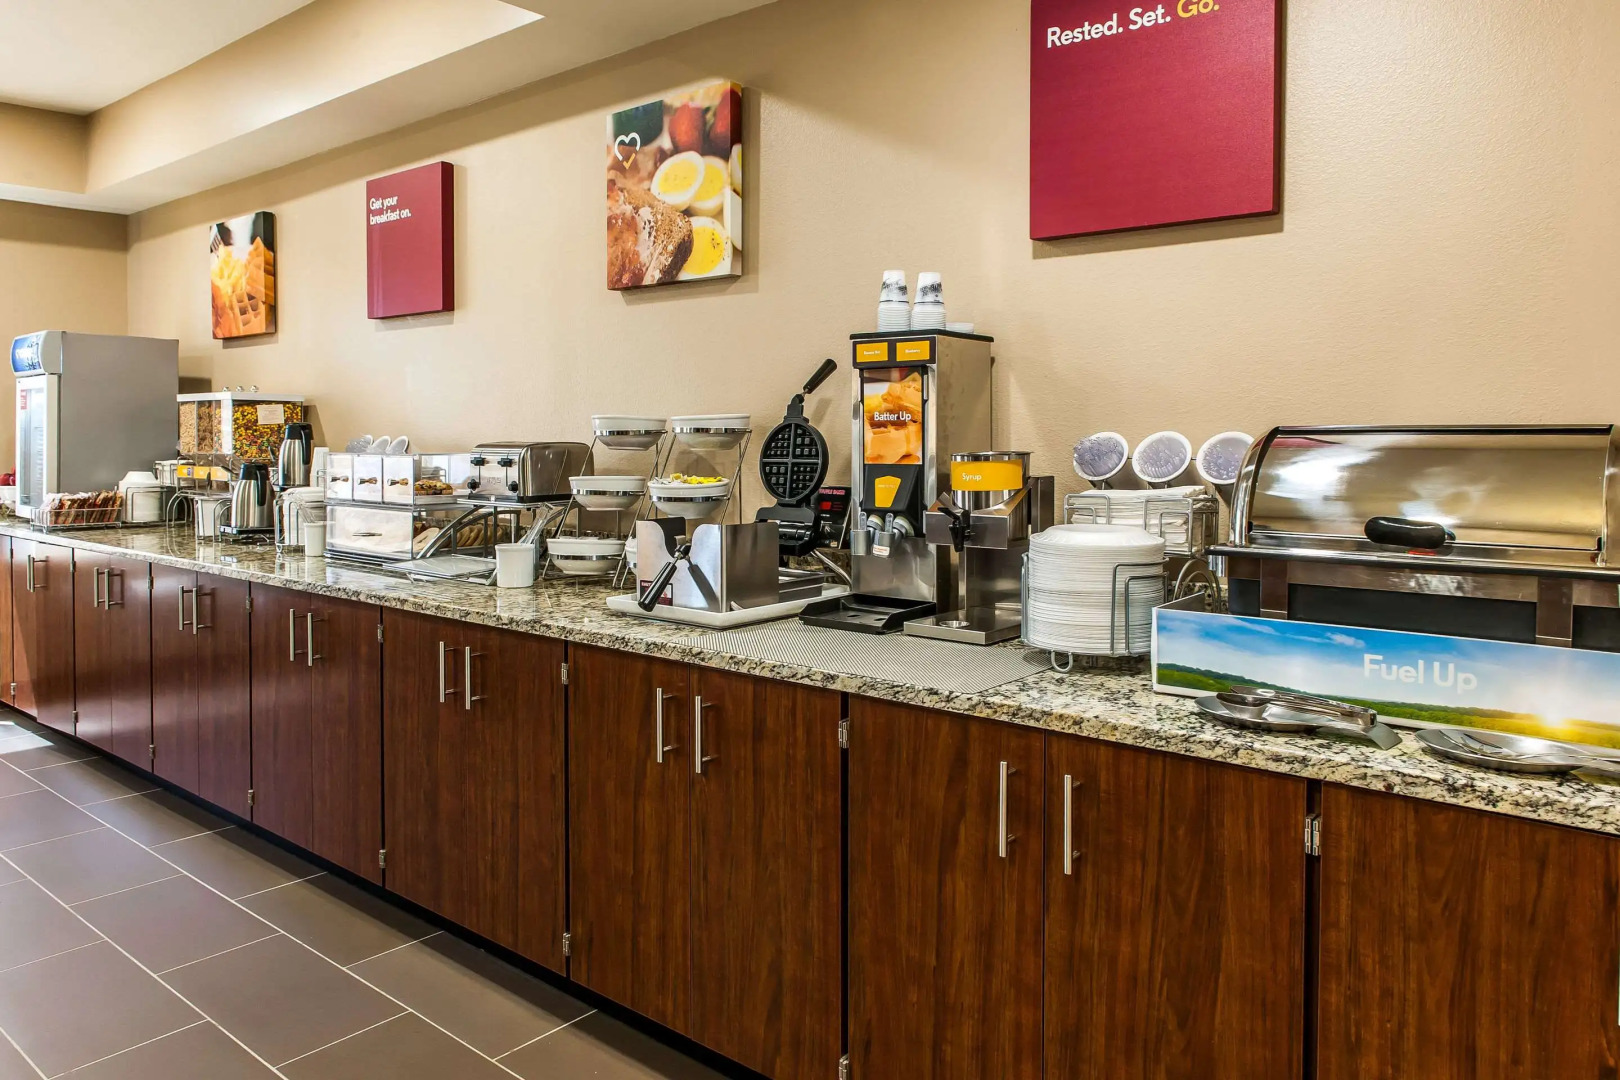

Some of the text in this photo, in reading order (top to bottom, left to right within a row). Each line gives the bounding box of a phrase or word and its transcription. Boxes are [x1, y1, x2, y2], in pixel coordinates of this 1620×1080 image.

[1047, 0, 1220, 48] Rested. Set. Go.
[369, 196, 398, 210] Get your
[369, 208, 412, 225] breakfast on.
[874, 411, 912, 422] Batter Up
[962, 472, 982, 482] Syrup
[1363, 653, 1478, 695] Fuel Up
